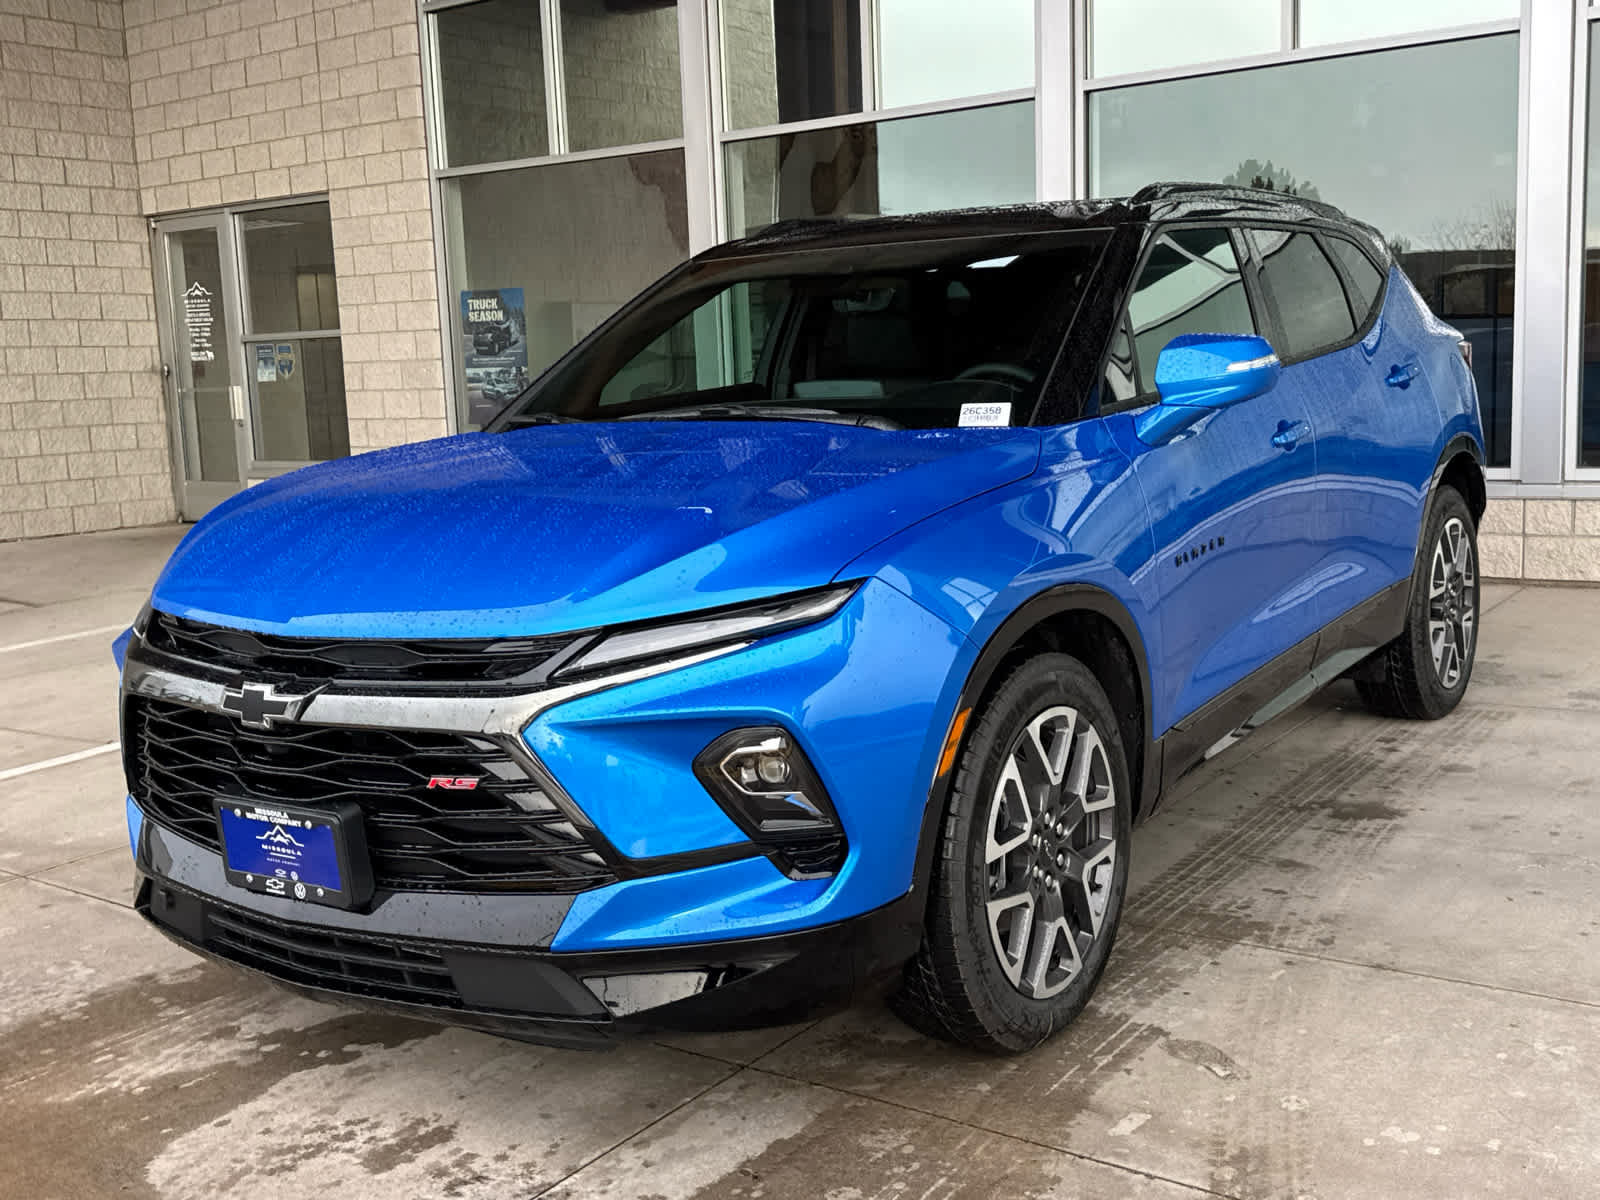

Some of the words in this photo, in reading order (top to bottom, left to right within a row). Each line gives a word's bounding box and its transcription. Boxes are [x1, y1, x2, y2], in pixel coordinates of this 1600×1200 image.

[467, 298, 498, 310] TRUCK
[468, 310, 504, 322] SEASON
[426, 777, 480, 790] RS
[245, 811, 270, 823] MOTOR
[269, 816, 302, 828] COMPANY
[261, 843, 303, 857] MISSOULA
